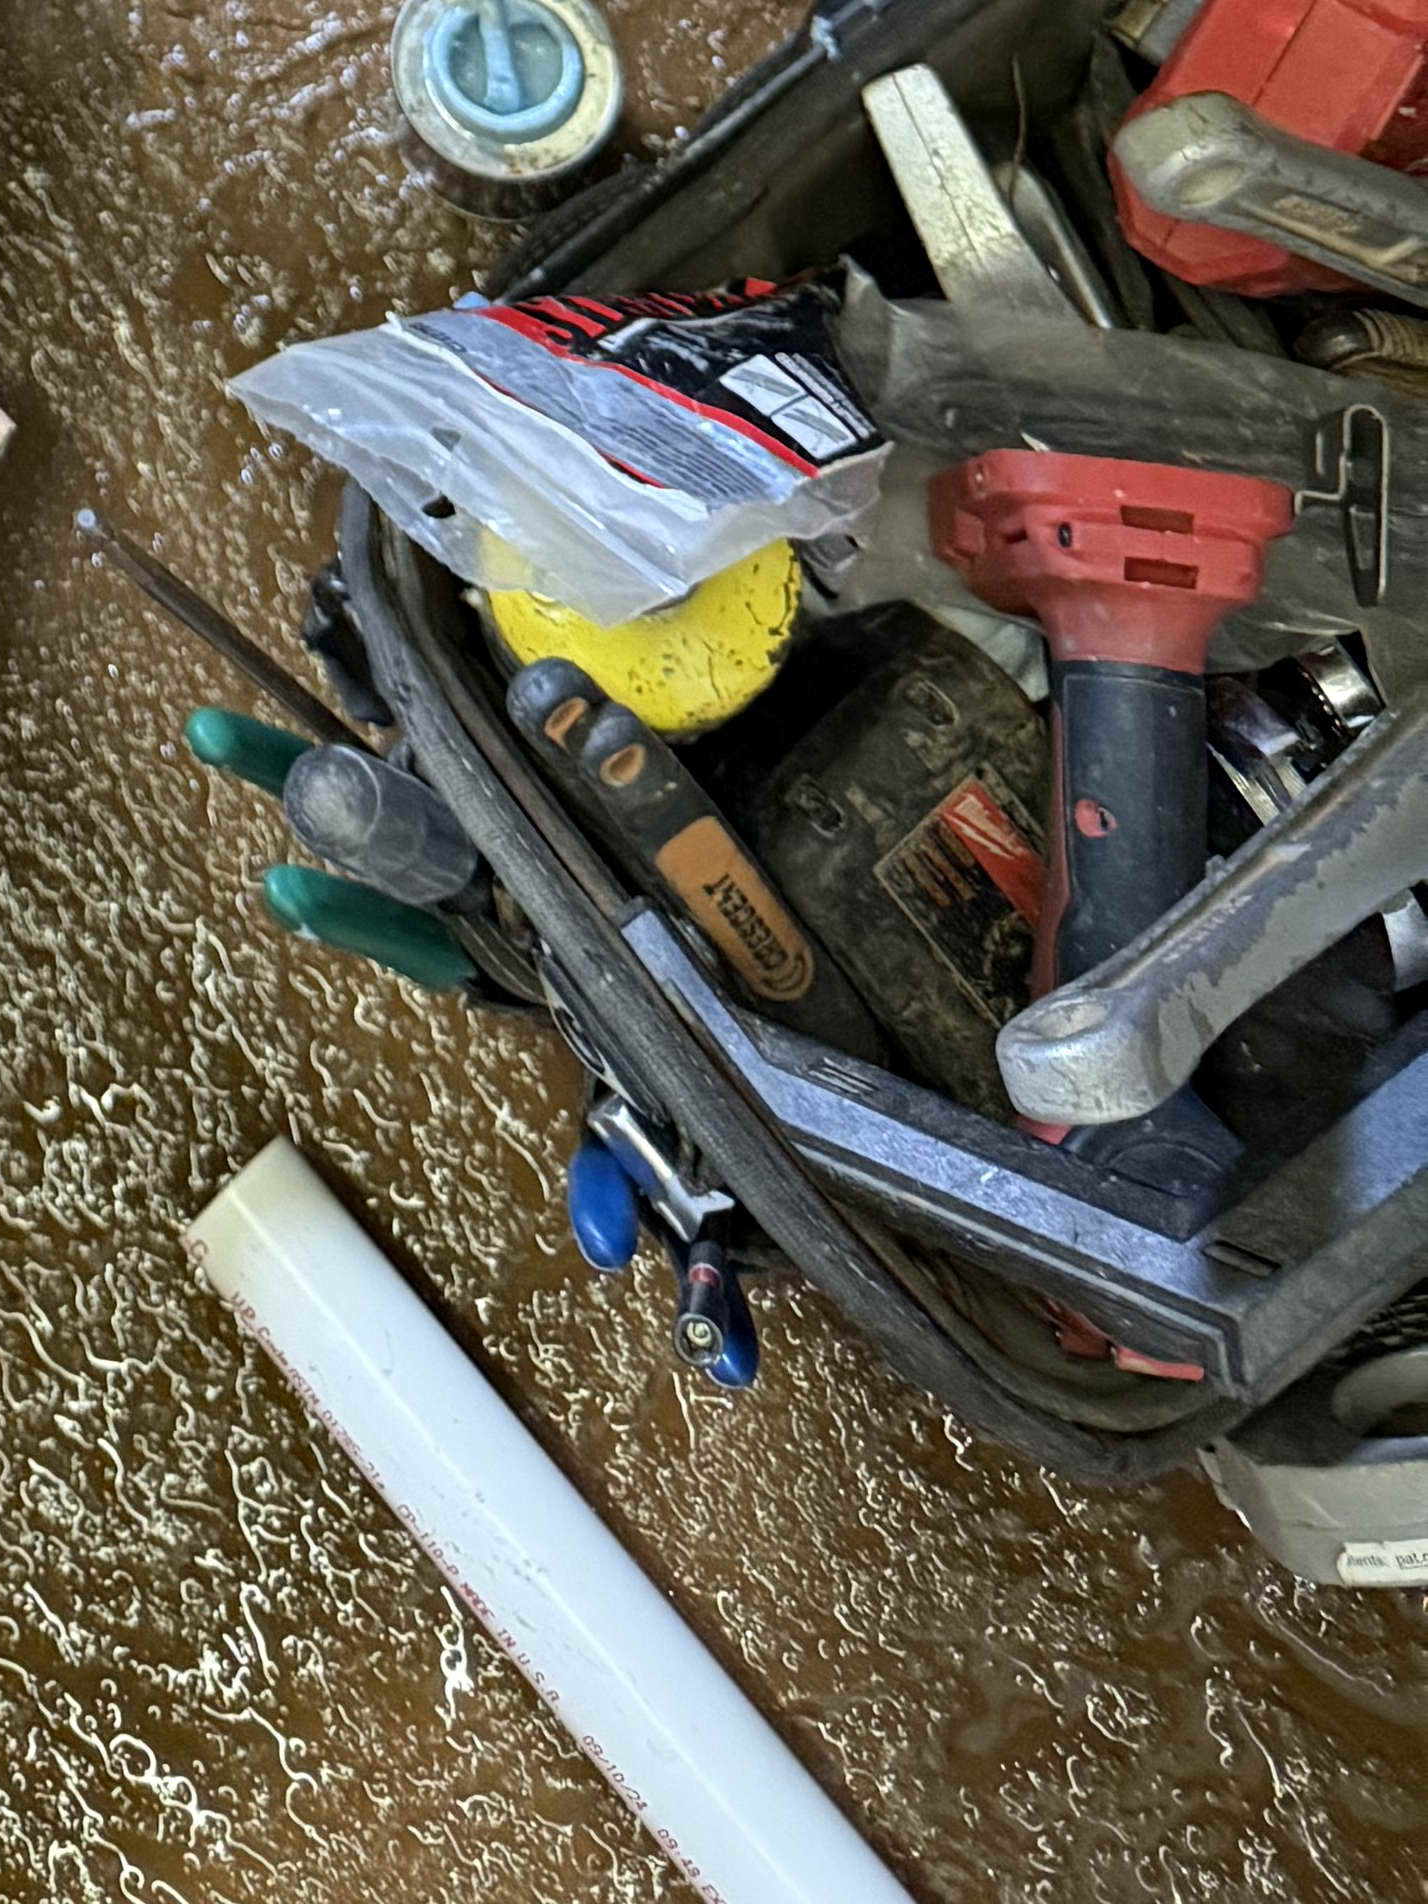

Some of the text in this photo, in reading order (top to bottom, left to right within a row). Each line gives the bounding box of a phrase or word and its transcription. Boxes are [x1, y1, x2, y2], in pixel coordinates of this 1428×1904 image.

[703, 873, 788, 970] CRESCENT
[460, 1582, 496, 1619] MADE
[498, 1628, 517, 1648] IN
